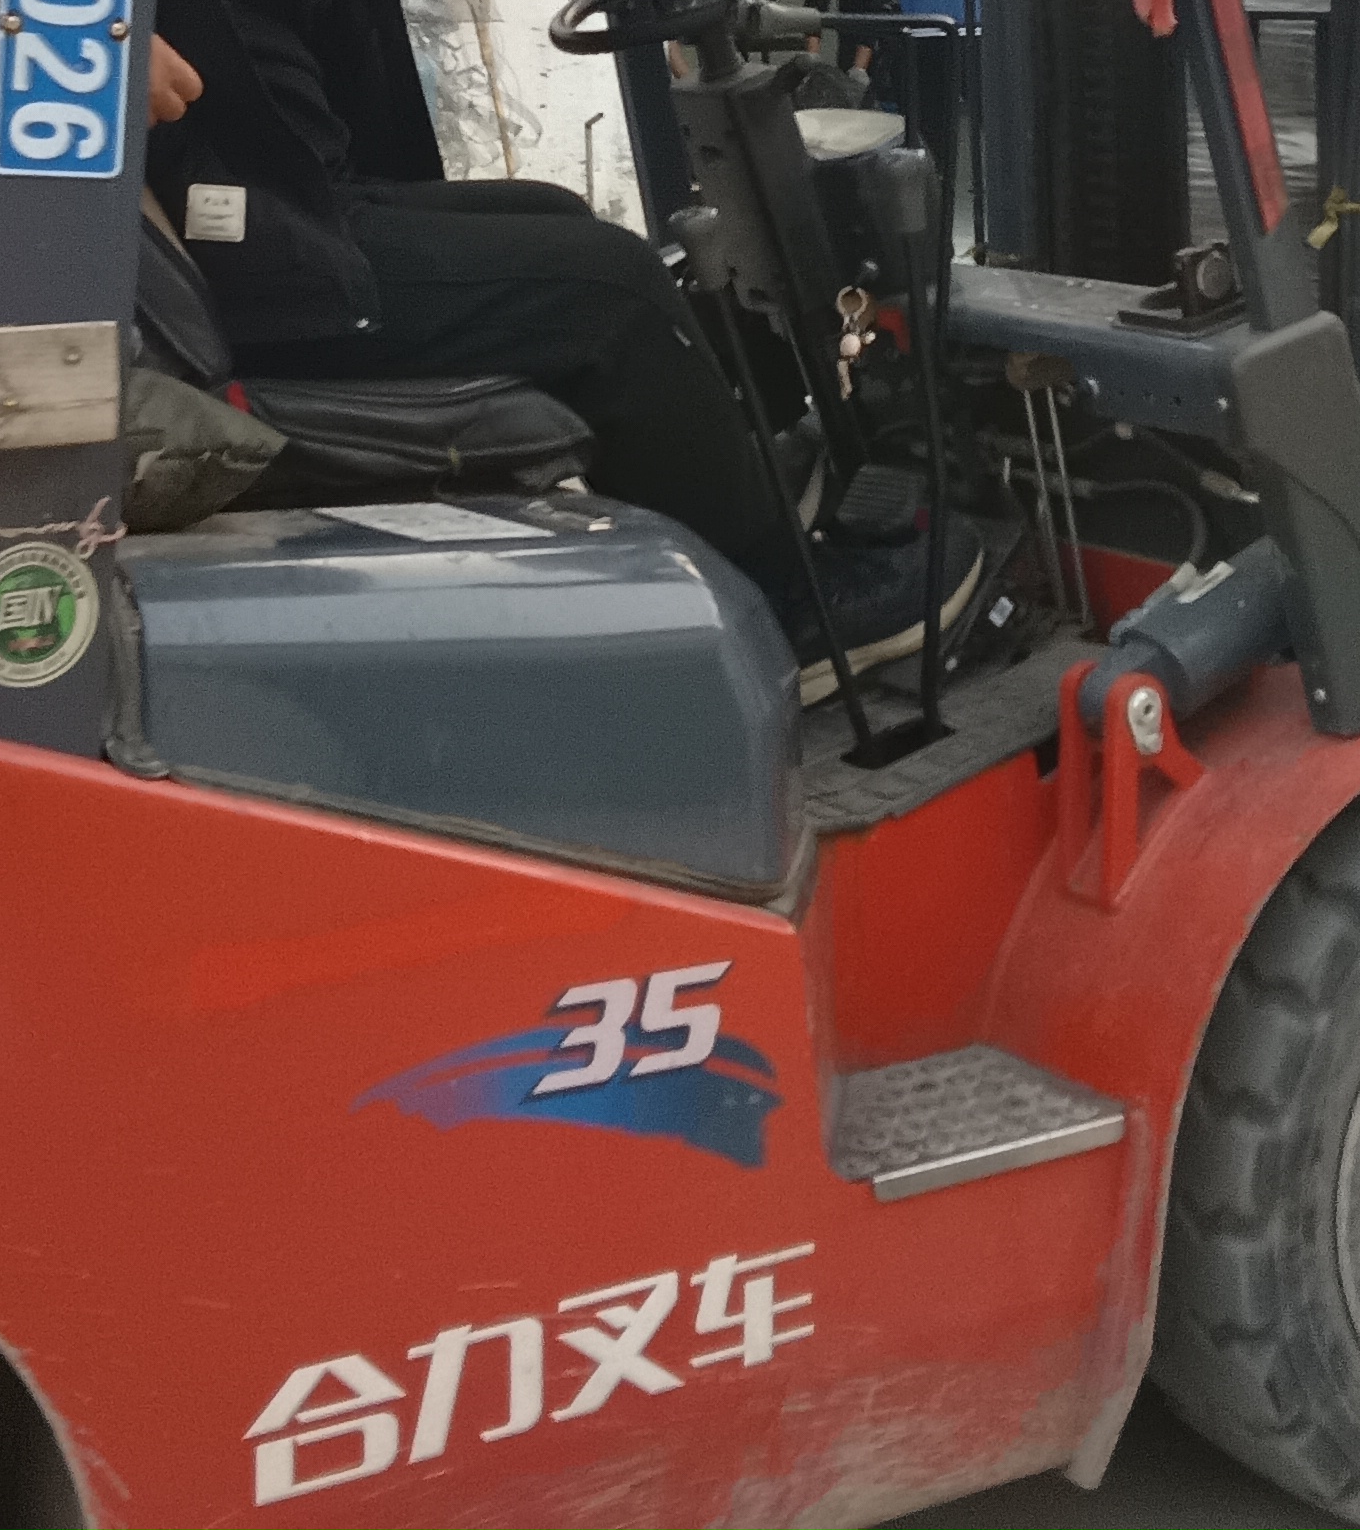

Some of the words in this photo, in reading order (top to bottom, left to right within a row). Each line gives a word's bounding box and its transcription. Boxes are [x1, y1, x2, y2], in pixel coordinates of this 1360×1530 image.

[532, 960, 733, 1096] 35
[242, 1241, 816, 1507] 合力叉车
